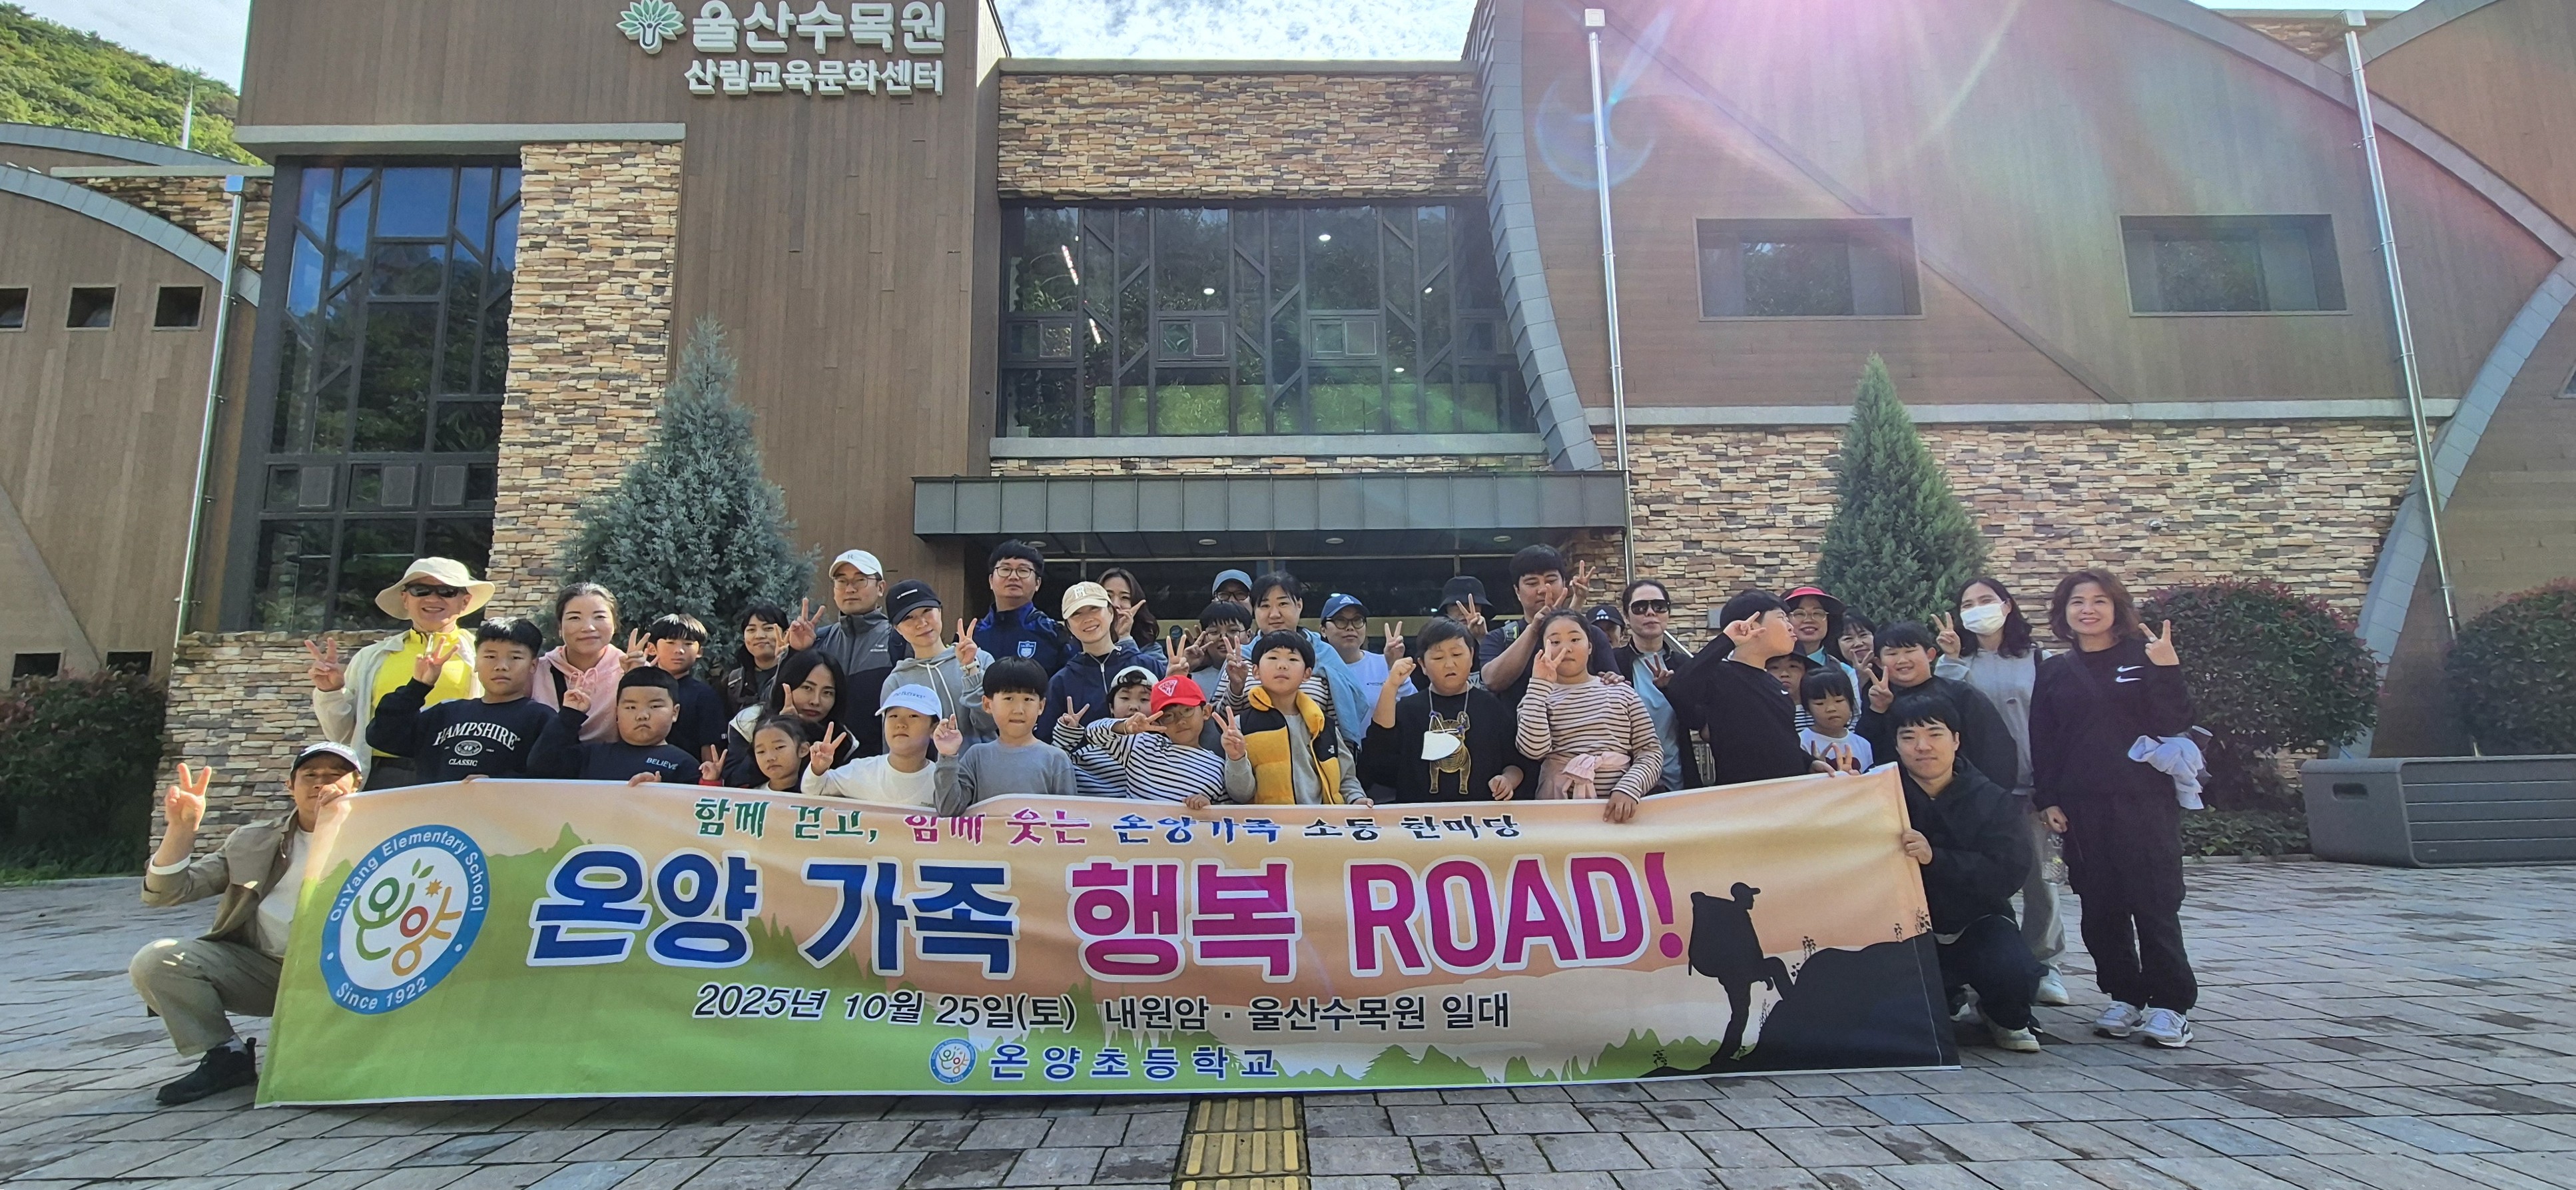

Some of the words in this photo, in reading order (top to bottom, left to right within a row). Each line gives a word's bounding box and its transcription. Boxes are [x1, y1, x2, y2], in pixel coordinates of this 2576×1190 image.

[692, 1, 945, 55] 울산수목원
[684, 59, 944, 96] 산림교육문화센터
[433, 722, 518, 751] HAMPSHIRE
[695, 798, 771, 839] 함께
[791, 805, 878, 843] 걷고,
[1007, 808, 1091, 844] 웃는
[1401, 814, 1520, 839] 한마당
[330, 858, 380, 922] OnYang
[382, 830, 468, 856] Elementary
[466, 852, 485, 912] School
[533, 850, 758, 960] 온양
[805, 862, 1016, 974] 가족
[1072, 862, 1296, 977] 행복
[1349, 852, 1683, 971] ROAD!
[336, 982, 378, 1010] Since
[386, 976, 428, 1008] 1922
[695, 984, 827, 1020] 2025년
[845, 992, 922, 1024] 10월
[936, 995, 1077, 1032] 25일(토)
[1106, 997, 1209, 1030] 내원암
[1247, 996, 1425, 1032] 울산수목원
[1443, 993, 1509, 1029] 일대
